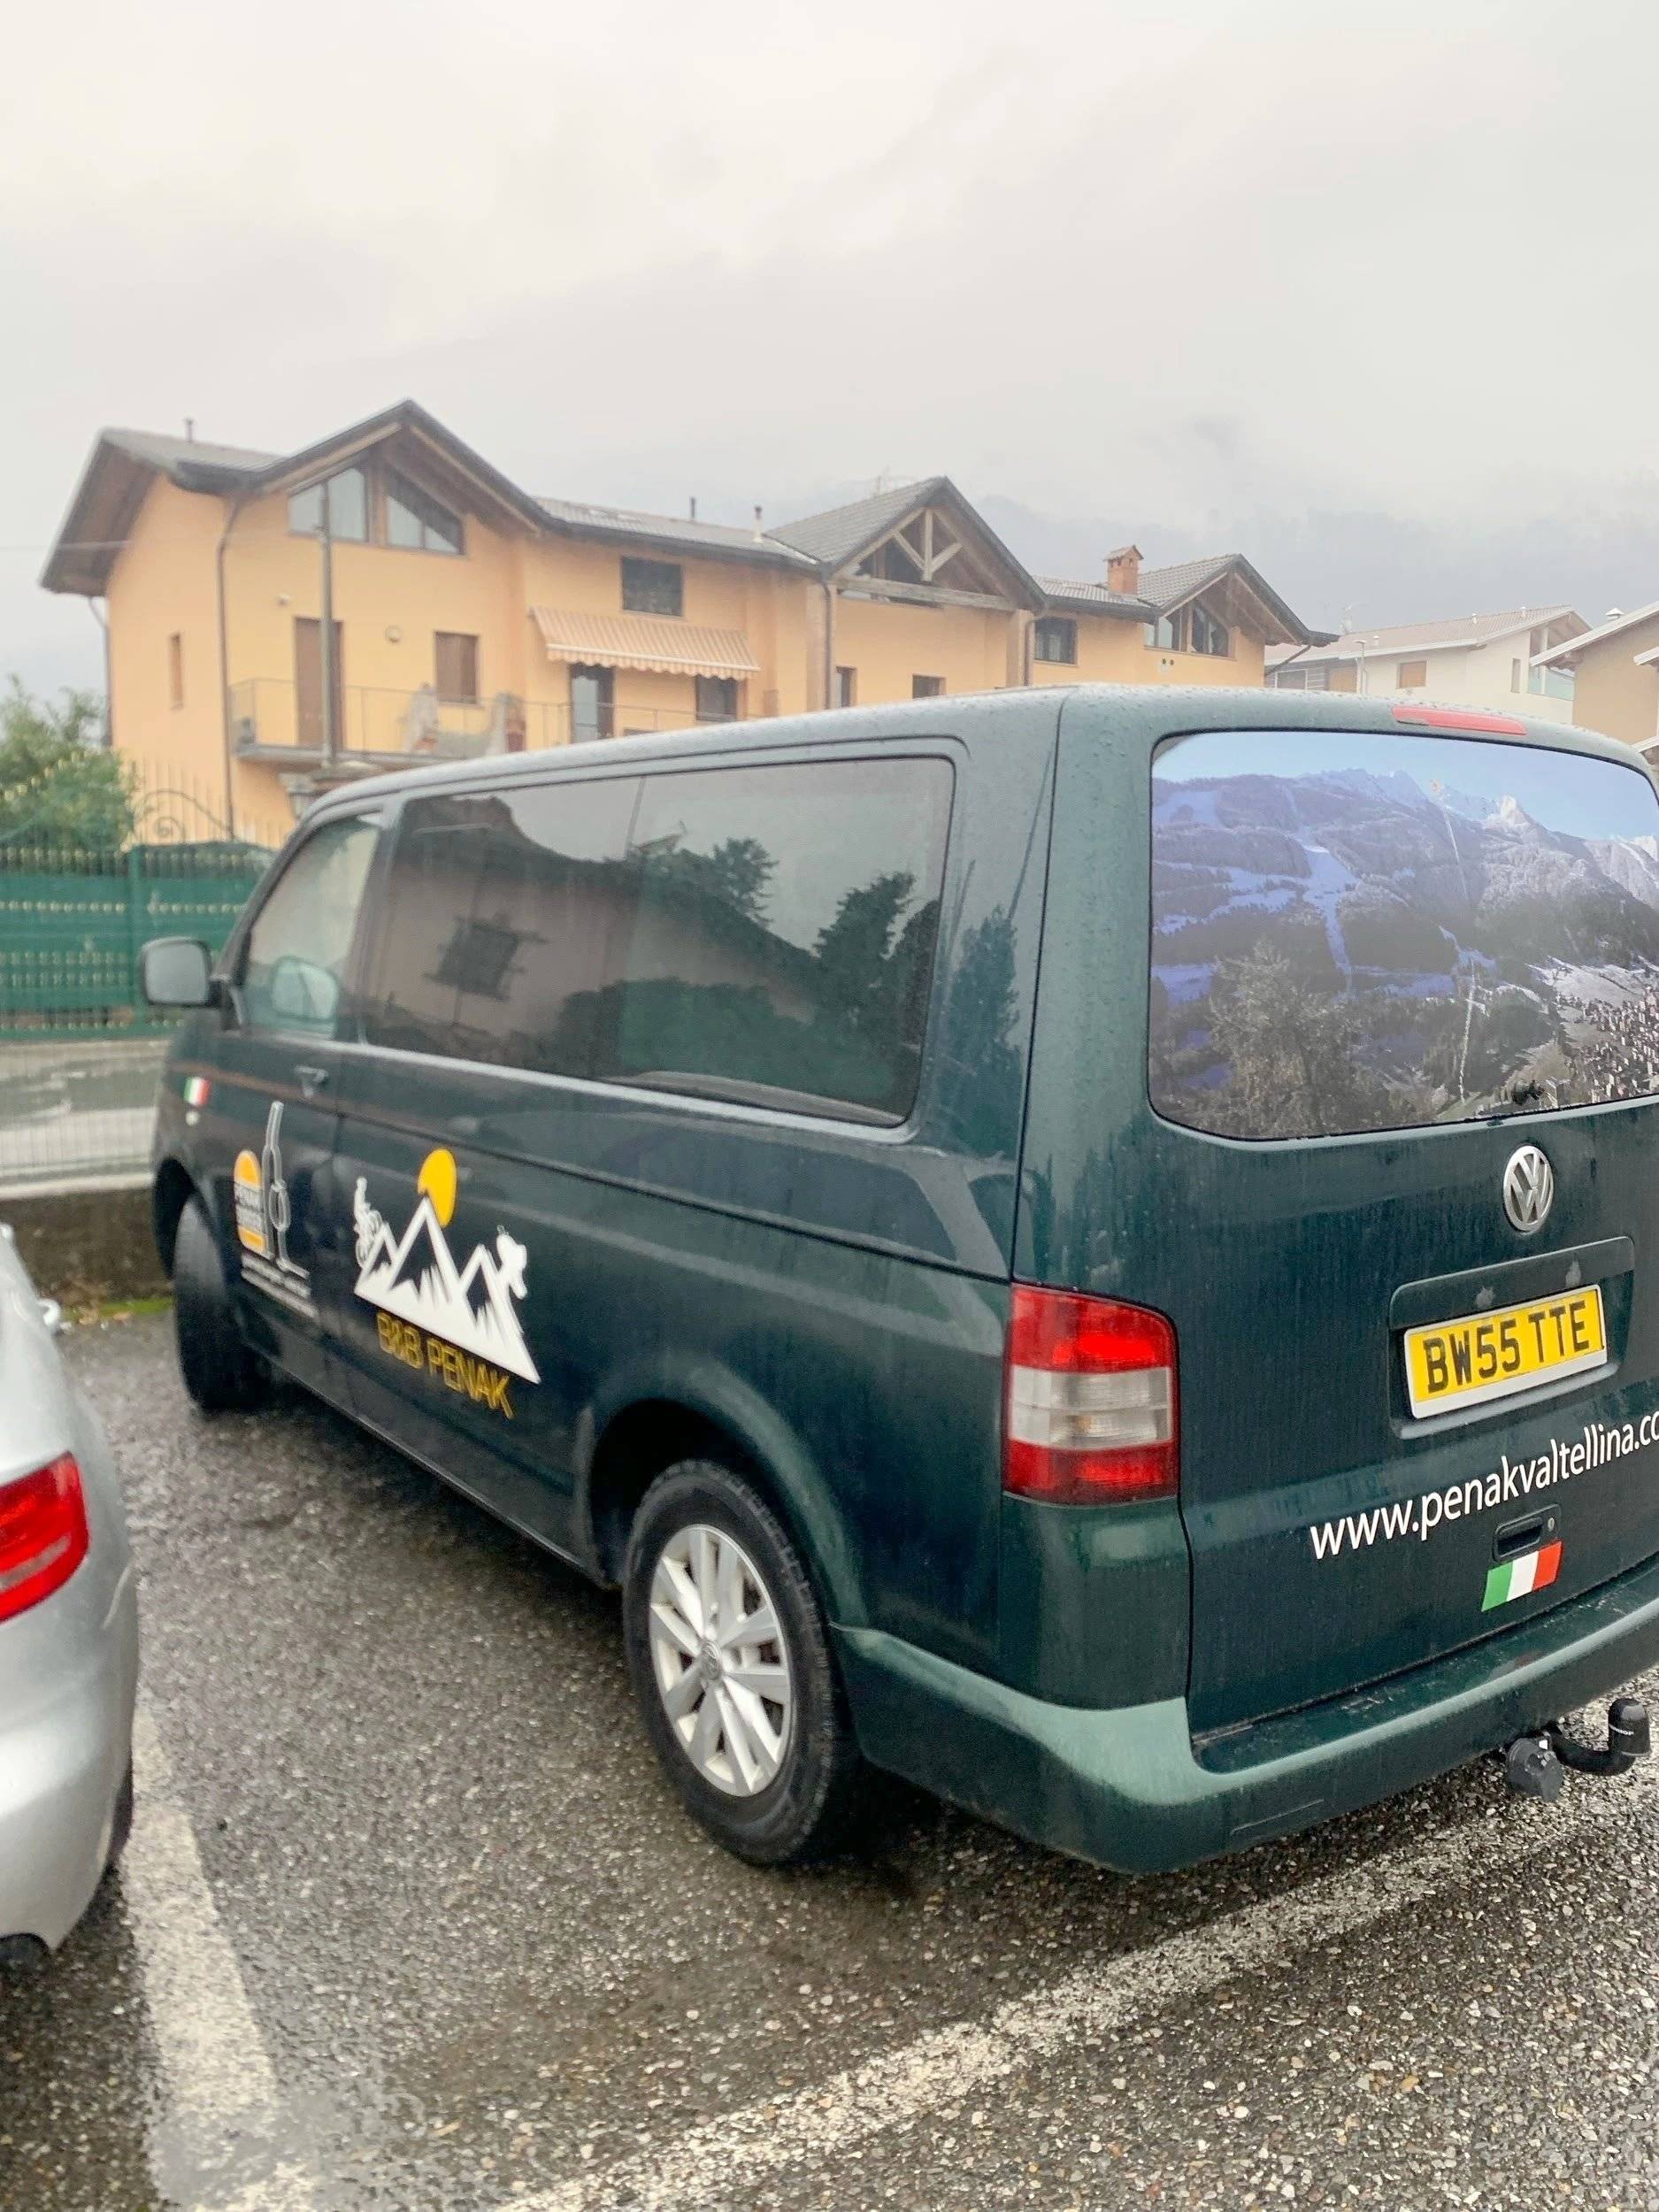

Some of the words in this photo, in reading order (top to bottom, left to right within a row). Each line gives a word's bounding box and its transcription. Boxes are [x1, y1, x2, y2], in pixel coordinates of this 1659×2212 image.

[1504, 1146, 1554, 1230] VW
[426, 1337, 516, 1419] PENAK
[1423, 1318, 1521, 1394] BW55
[1528, 1300, 1590, 1363] TTE
[1310, 1410, 1659, 1560] www.penakvaltellina.co
